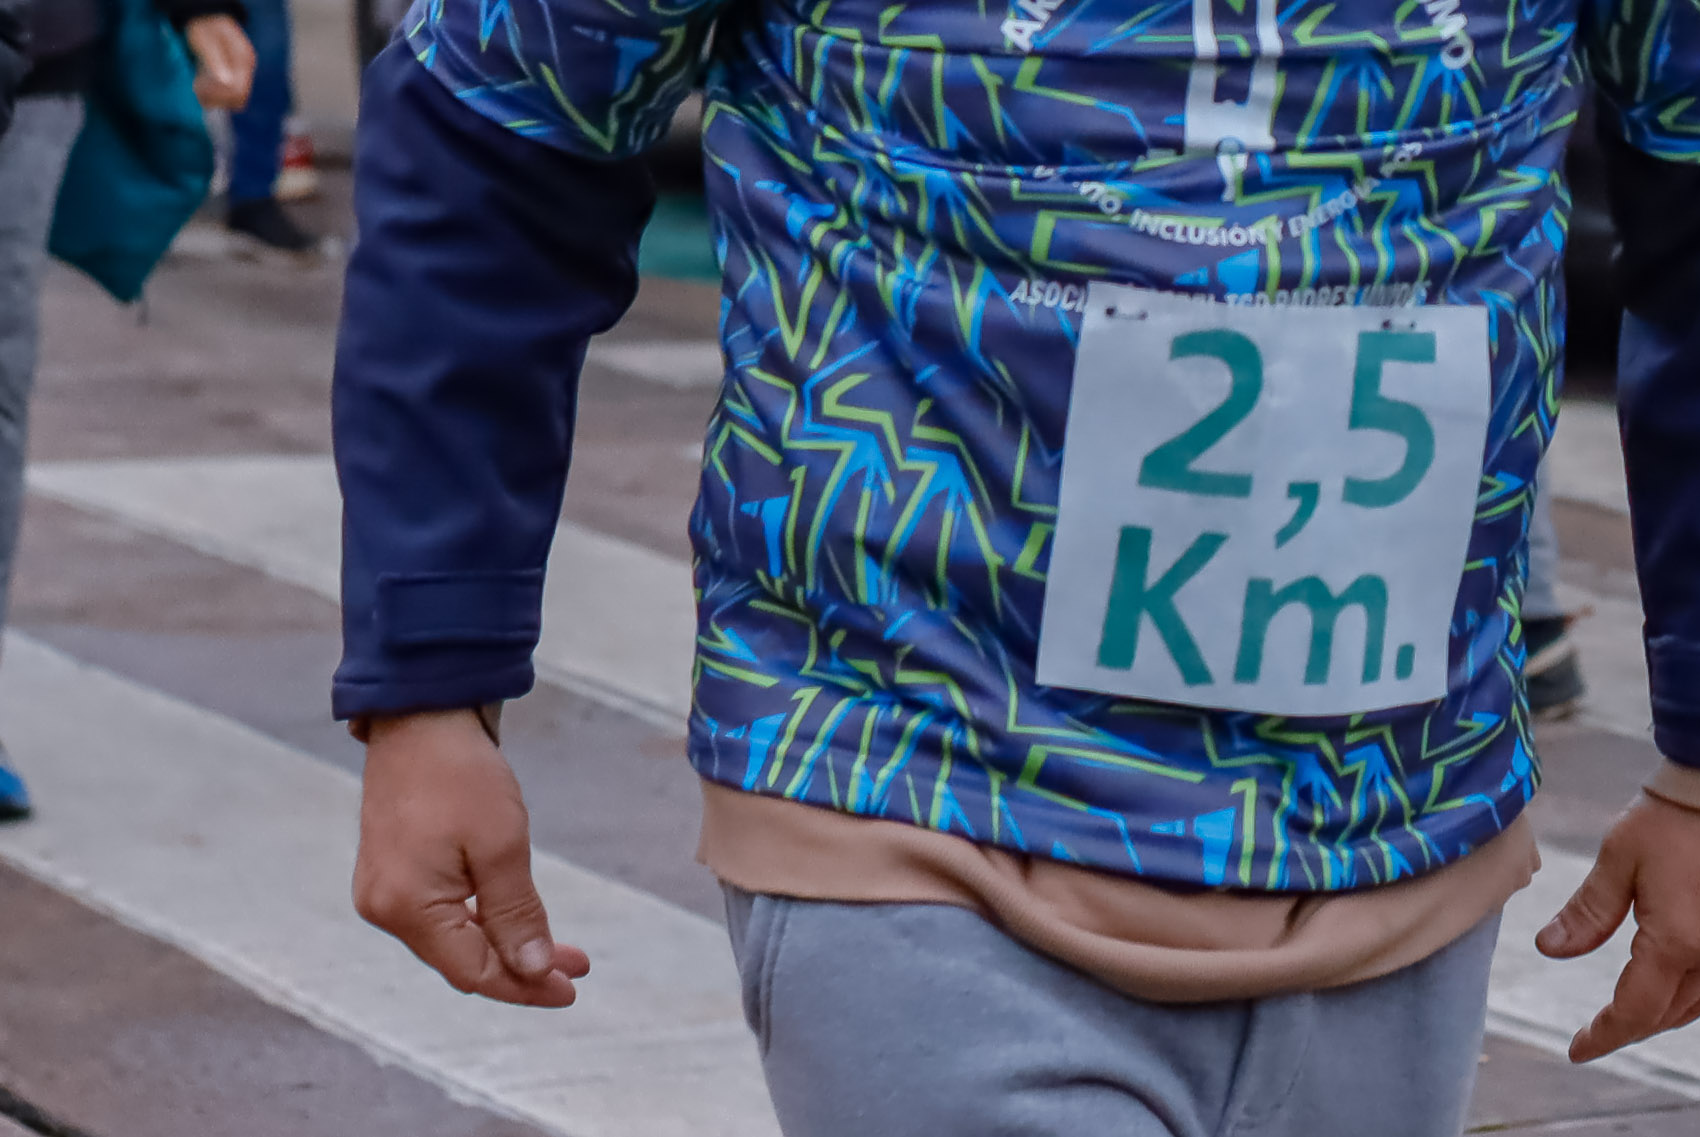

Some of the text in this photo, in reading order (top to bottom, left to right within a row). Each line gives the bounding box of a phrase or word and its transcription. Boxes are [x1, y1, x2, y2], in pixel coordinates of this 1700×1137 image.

[1009, 279, 1086, 313] ASOCI
[1137, 328, 1437, 550] 2,5
[1096, 524, 1416, 687] Km.
